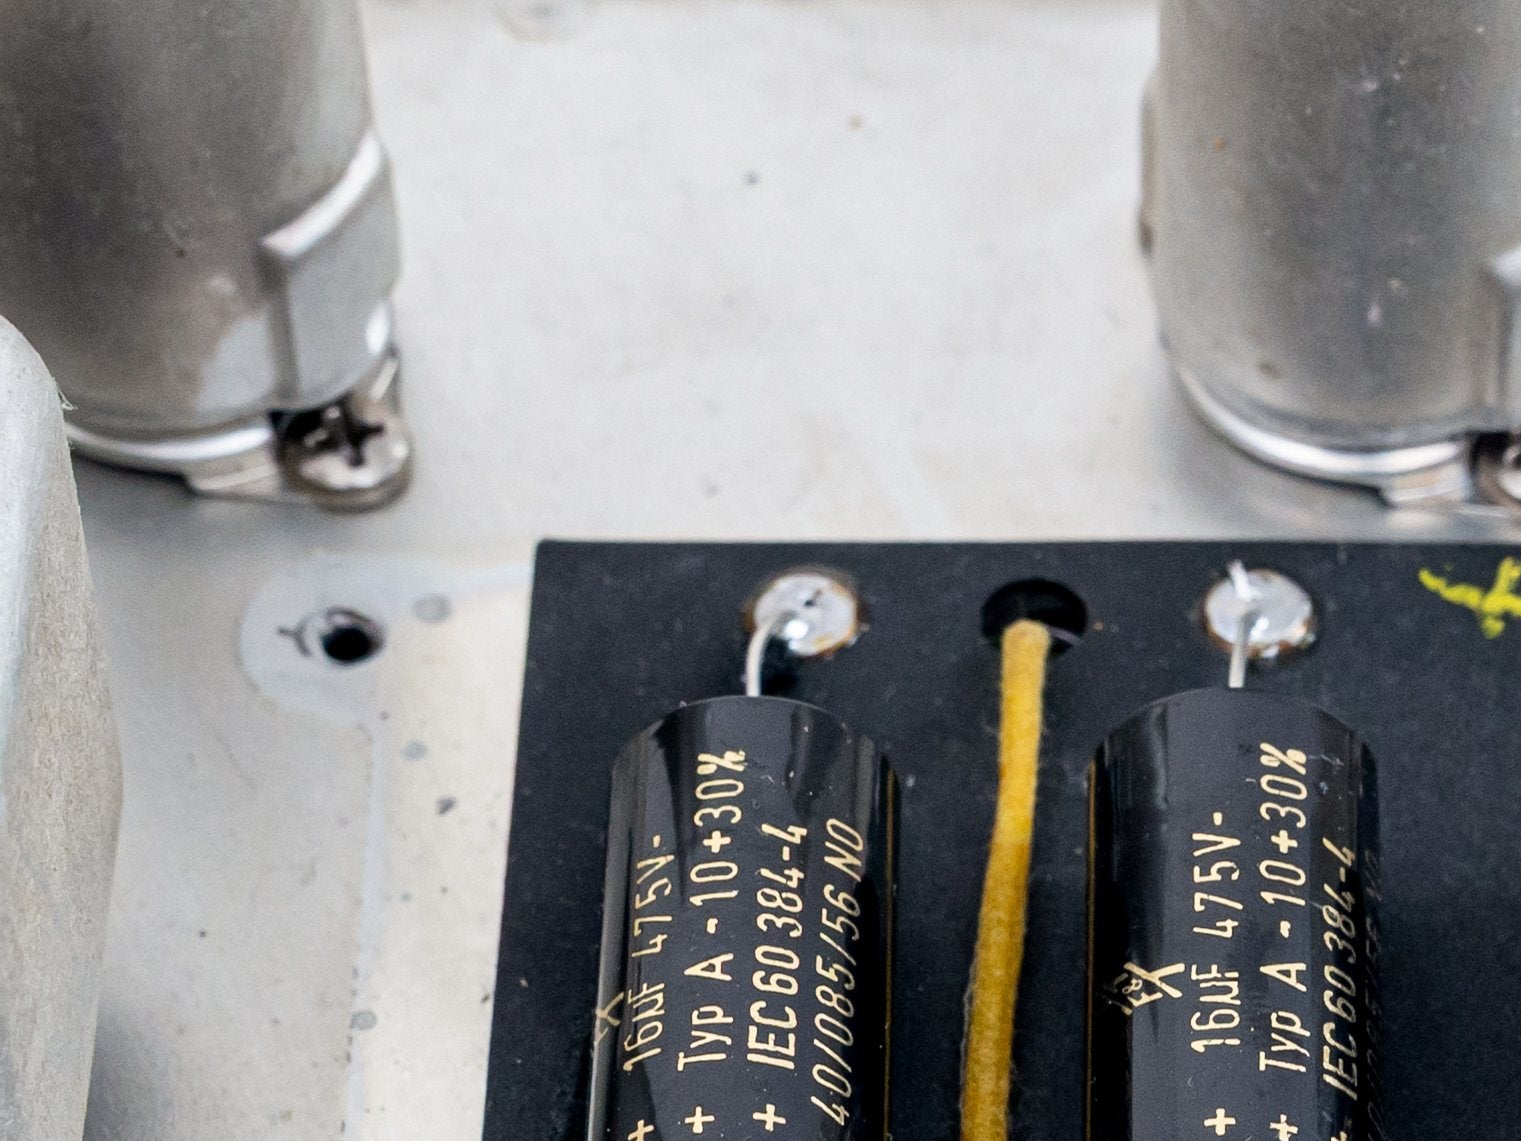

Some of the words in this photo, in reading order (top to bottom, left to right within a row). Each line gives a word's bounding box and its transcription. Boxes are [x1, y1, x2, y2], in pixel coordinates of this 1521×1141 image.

[684, 953, 734, 980] A
[1260, 962, 1306, 992] A
[810, 884, 862, 1126] 40/085/56
[677, 1004, 734, 1071] Typ
[1260, 1011, 1310, 1072] Typ
